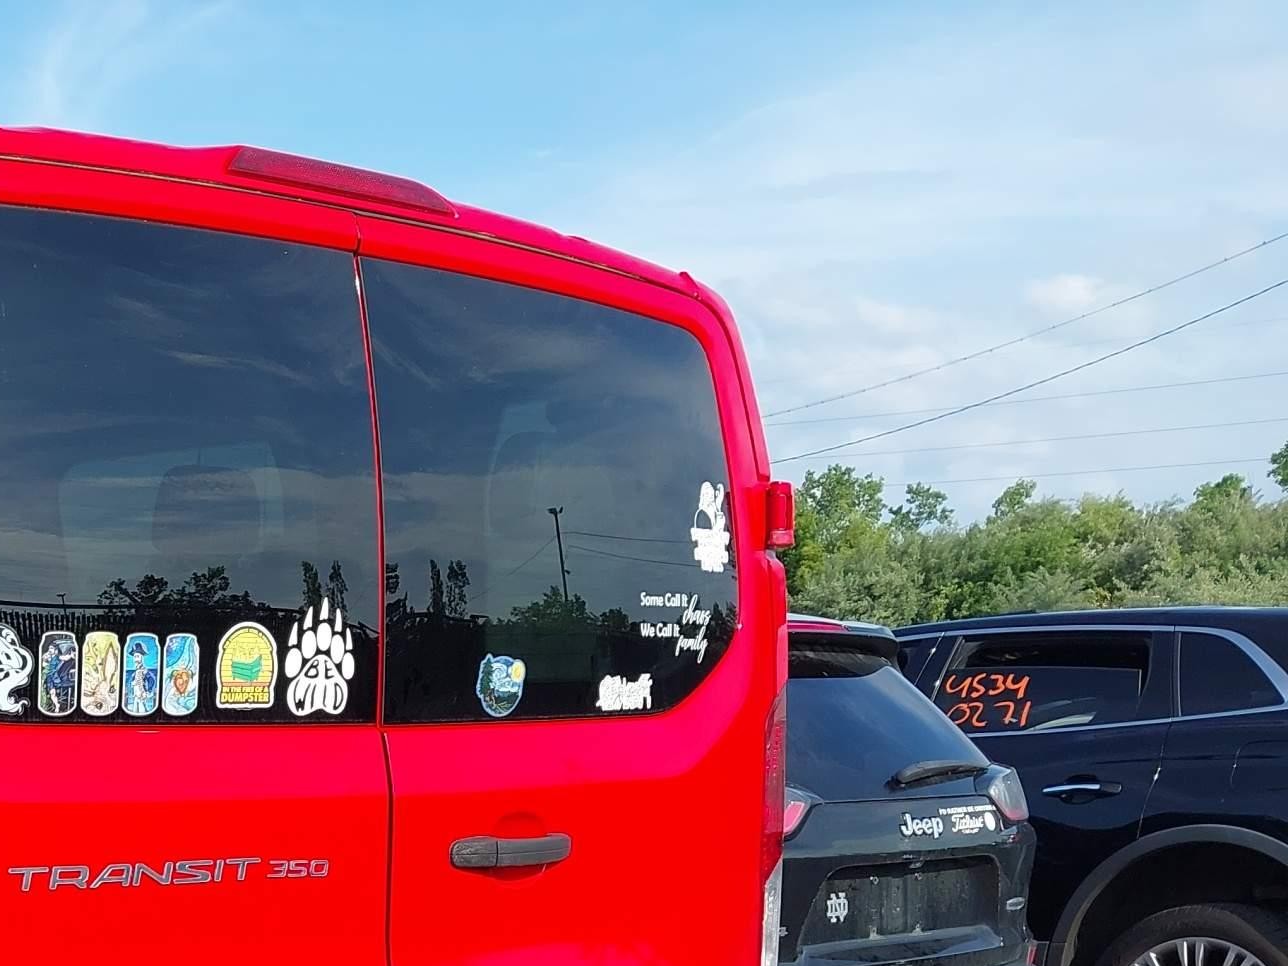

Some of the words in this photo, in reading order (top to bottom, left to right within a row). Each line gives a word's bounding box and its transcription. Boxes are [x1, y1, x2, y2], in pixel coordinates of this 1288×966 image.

[640, 591, 664, 607] Some
[665, 592, 680, 607] Call
[681, 593, 688, 607] It
[682, 594, 711, 626] chaos
[640, 623, 655, 637] We
[656, 623, 672, 637] Call
[673, 624, 680, 637] It
[675, 626, 709, 664] family
[304, 659, 335, 679] BE
[221, 693, 269, 703] DUMPSTER
[293, 678, 344, 712] WILD
[946, 673, 1030, 699] 4534
[899, 812, 944, 838] Jeep
[8, 857, 262, 892] TRANSIT
[266, 859, 329, 878] 350
